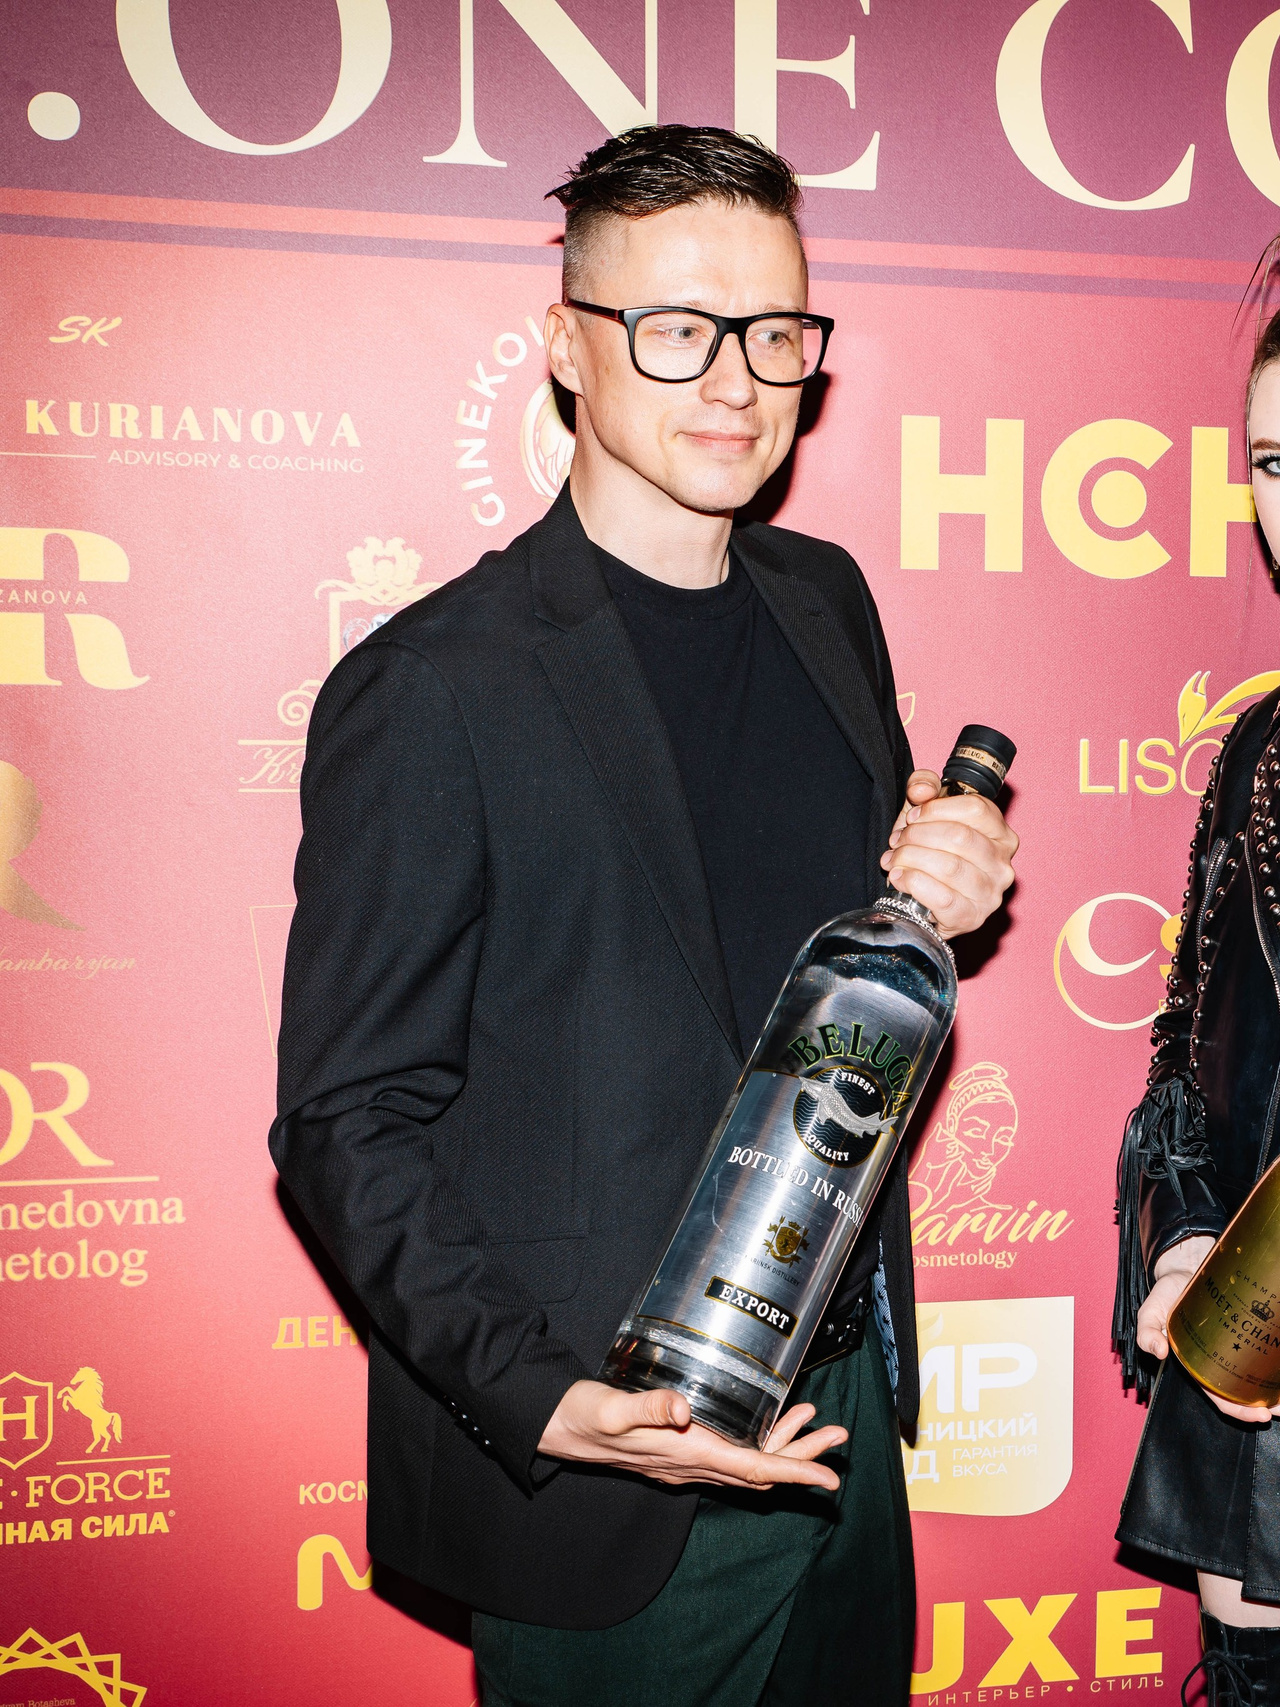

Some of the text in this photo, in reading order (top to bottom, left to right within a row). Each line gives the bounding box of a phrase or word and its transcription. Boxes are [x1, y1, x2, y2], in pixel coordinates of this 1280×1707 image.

[49, 316, 122, 346] SK
[25, 399, 362, 448] KURIANOVA
[108, 450, 365, 474] ADVISORY & COACHING
[0, 589, 88, 605] ANOVA
[841, 1071, 876, 1097] FINEST
[807, 1134, 850, 1162] QUALITY
[811, 1176, 836, 1202] IN
[832, 1189, 866, 1229] RUSSI
[0, 1238, 148, 1287] etolog
[718, 1284, 790, 1330] EXPORT
[1212, 1350, 1238, 1372] BRUT
[952, 1443, 1039, 1461] ГАРАНТИЯ
[952, 1462, 1009, 1478] ВКУСА
[26, 1467, 171, 1508] FORCE
[0, 1511, 170, 1546] НАЯ СИЛА
[928, 1676, 1165, 1706] ИНТЕРЬЕР СТИЛЬ
